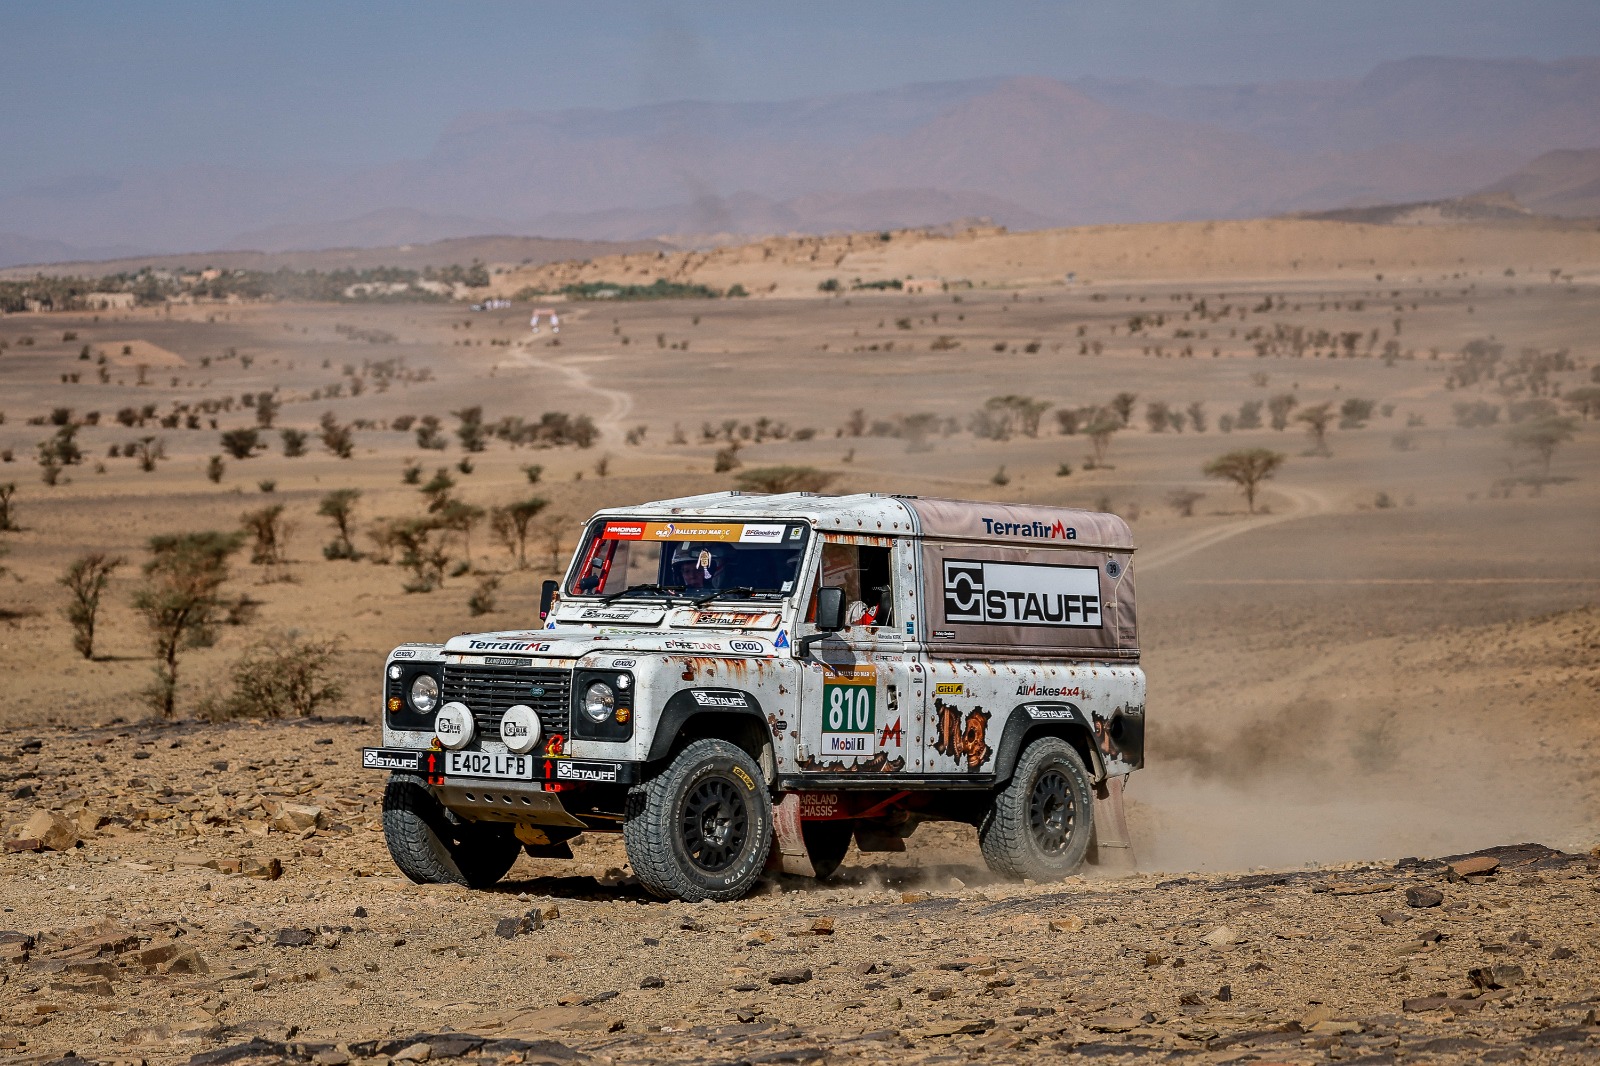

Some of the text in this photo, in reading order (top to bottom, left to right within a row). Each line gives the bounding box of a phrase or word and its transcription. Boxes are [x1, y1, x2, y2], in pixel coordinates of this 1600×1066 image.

[1109, 563, 1117, 573] 39
[986, 589, 1099, 622] STAUFF
[595, 612, 630, 620] STAUFF
[709, 617, 747, 625] STAUFF
[485, 657, 501, 665] LAND
[499, 658, 517, 666] ROVER
[938, 685, 954, 693] Giti
[1015, 683, 1080, 697] AllMakes4x4
[709, 696, 745, 706] STAUFF
[829, 686, 870, 731] 810
[1039, 709, 1073, 719] STAUFF
[831, 737, 865, 750] Mobil 1
[376, 756, 418, 768] STAUFF
[452, 753, 526, 775] E402 LFB
[572, 769, 615, 780] STAUFF
